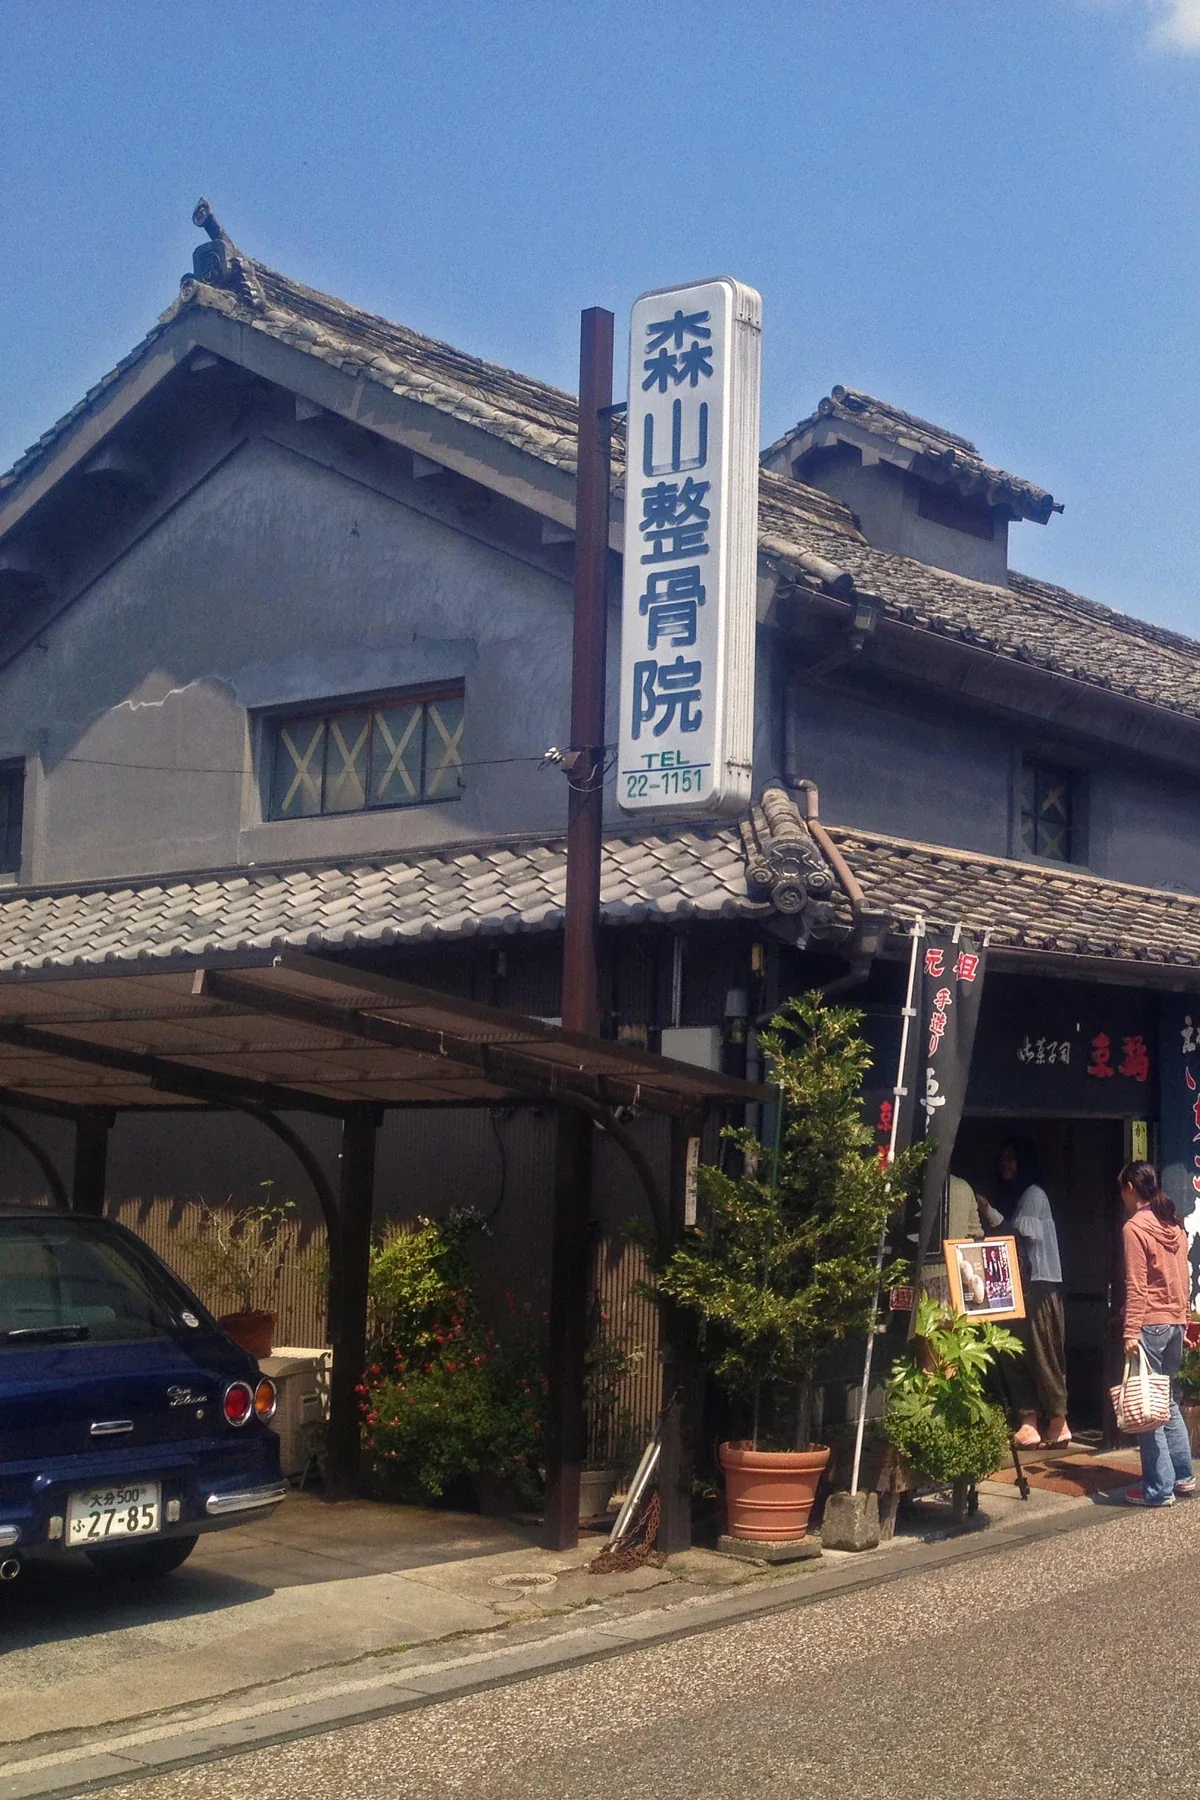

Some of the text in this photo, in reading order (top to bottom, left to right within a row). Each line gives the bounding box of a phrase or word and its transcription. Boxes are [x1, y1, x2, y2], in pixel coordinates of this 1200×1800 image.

[632, 310, 714, 741] 森山整骨院
[641, 751, 690, 769] TEL
[626, 767, 702, 799] 22-1151
[928, 987, 952, 1058] 手造り
[90, 1488, 140, 1508] 大分 500
[72, 1503, 155, 1539] ふ 27-85
